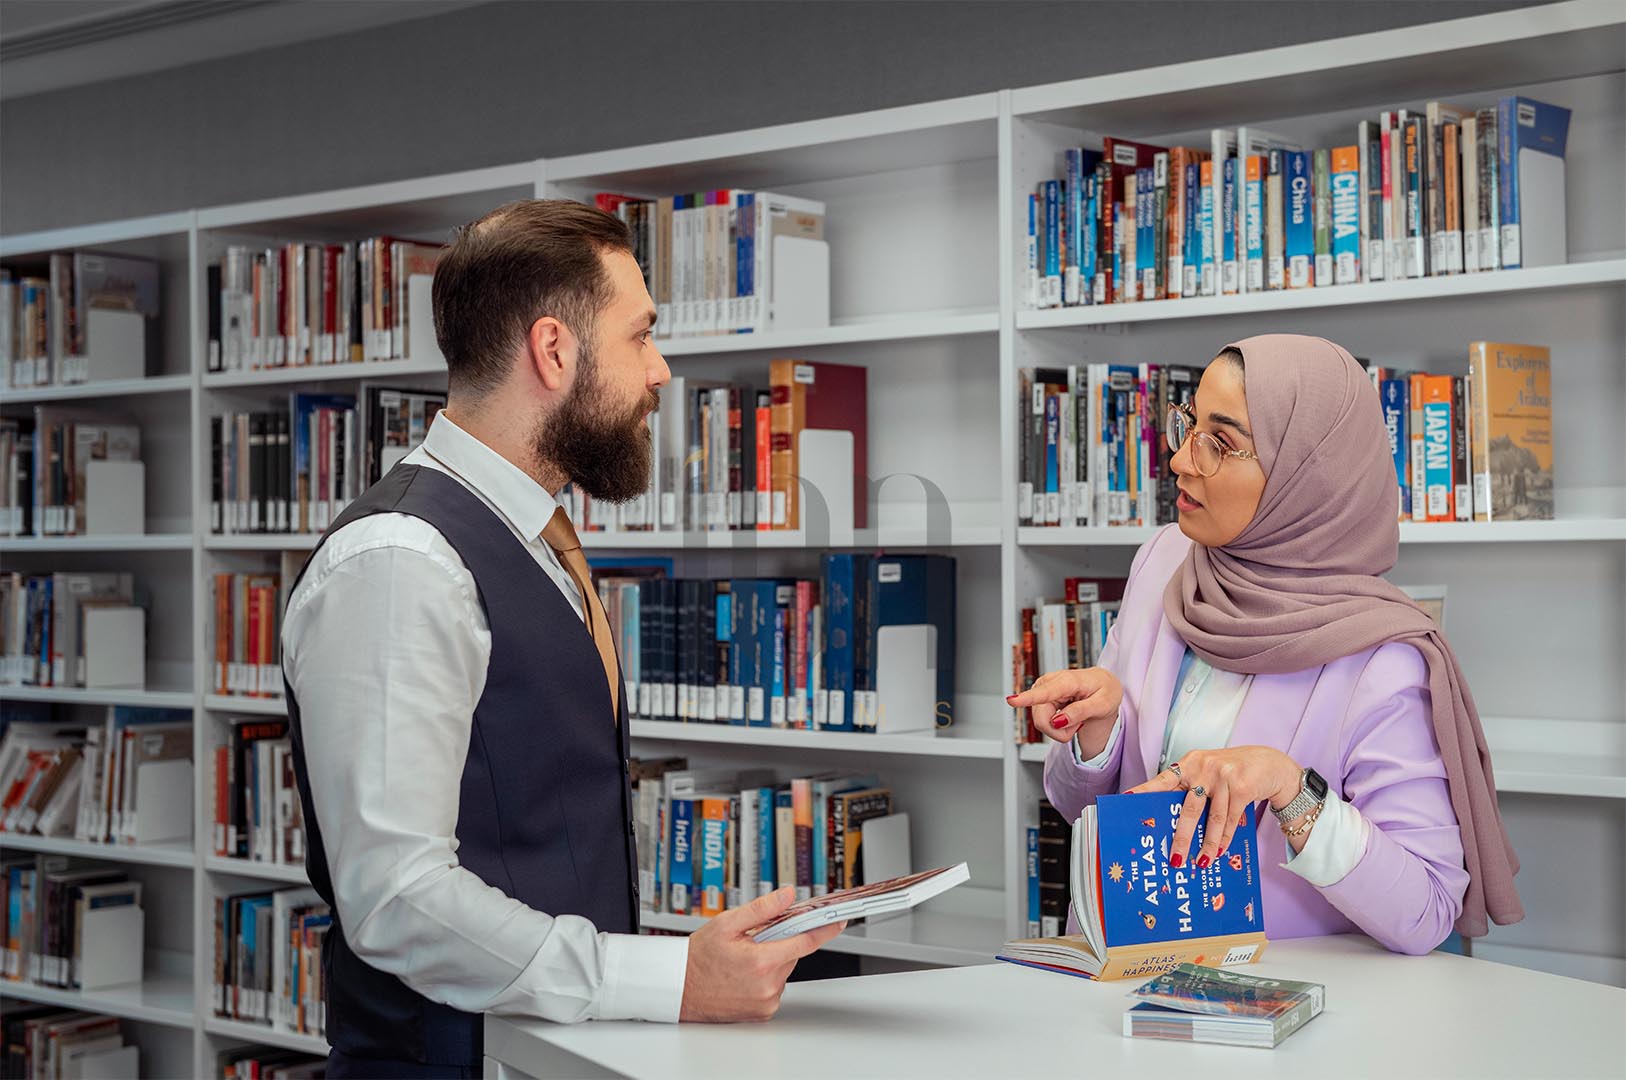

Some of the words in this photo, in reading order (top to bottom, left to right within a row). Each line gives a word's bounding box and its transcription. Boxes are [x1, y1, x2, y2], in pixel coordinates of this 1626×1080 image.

[1246, 183, 1261, 250] PHILIPPINES
[1291, 177, 1307, 224] China
[1332, 173, 1356, 239] CHINA
[1386, 406, 1400, 465] Japan
[1425, 406, 1448, 470] JAPAN
[675, 819, 688, 863] India
[705, 821, 722, 870] INDIA
[1131, 861, 1139, 882] THE
[1141, 834, 1159, 906] ATLAS
[1161, 861, 1169, 876] OF
[1208, 877, 1214, 887] OF
[1215, 876, 1222, 888] BE
[1142, 954, 1176, 966] ATLAS
